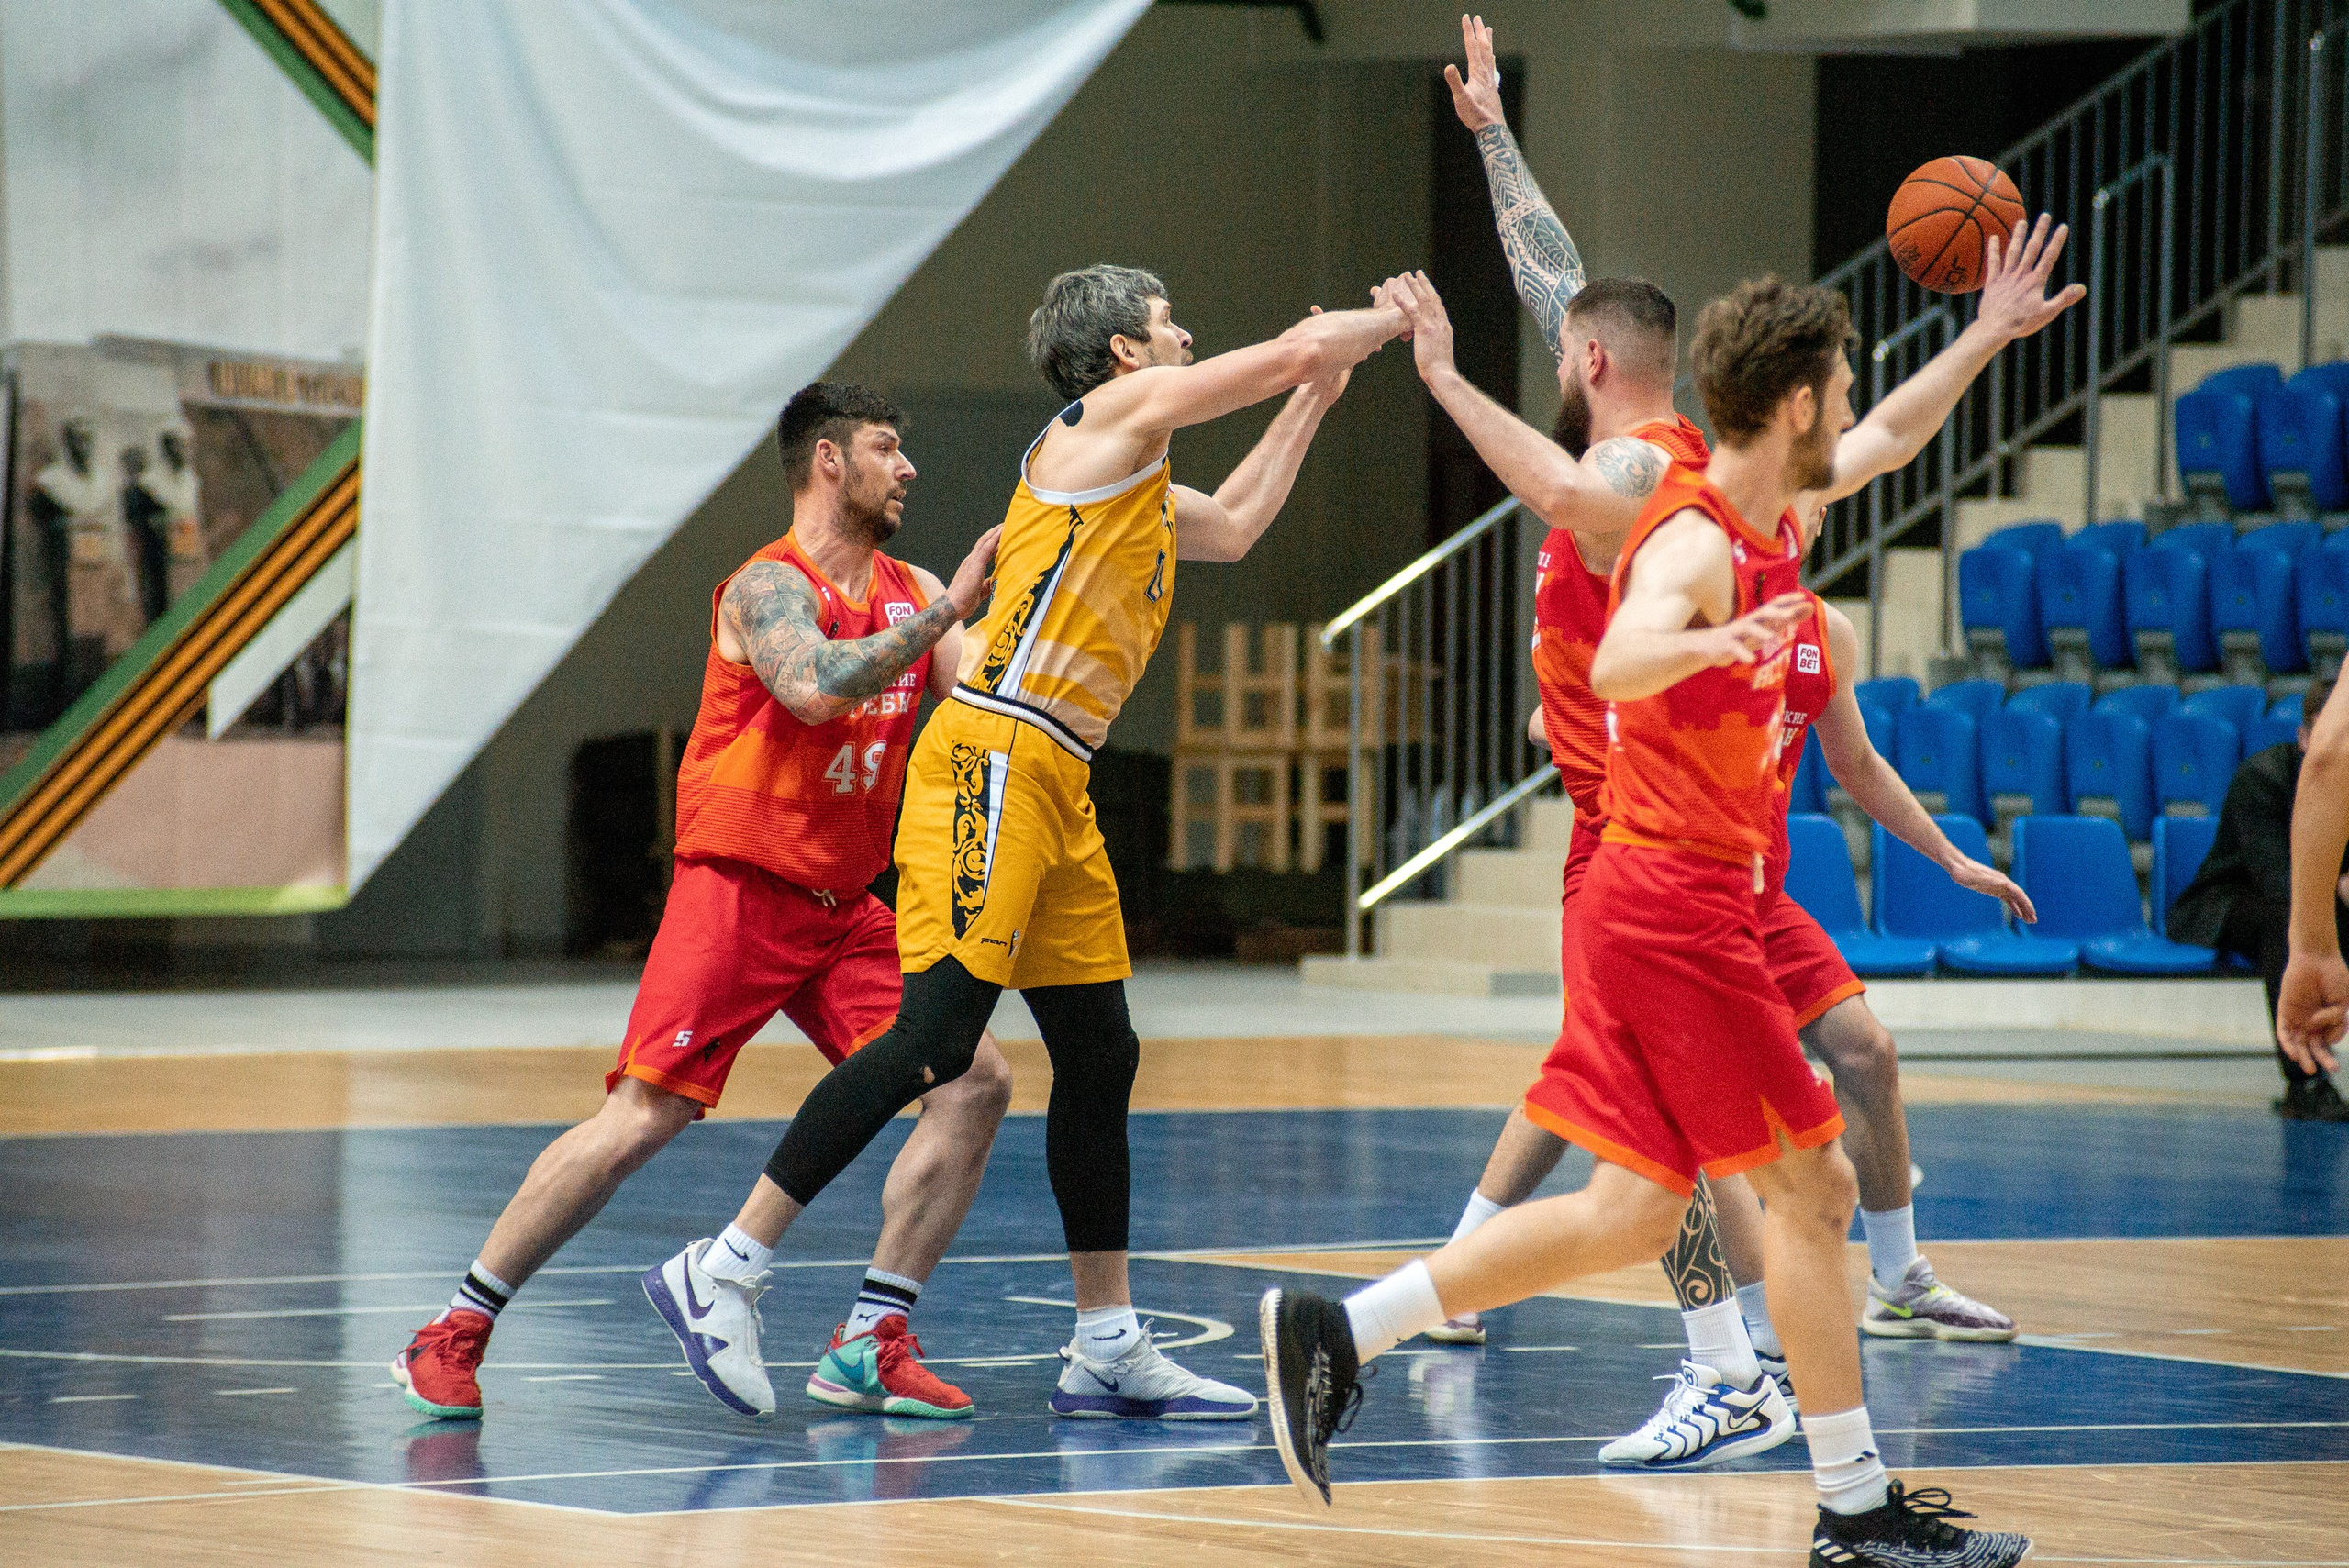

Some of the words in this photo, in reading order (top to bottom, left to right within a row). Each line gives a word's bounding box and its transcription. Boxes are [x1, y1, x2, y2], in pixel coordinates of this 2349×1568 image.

[889, 606, 911, 616] FON
[893, 616, 911, 625] BE
[1799, 648, 1818, 659] FON
[1799, 658, 1818, 670] BET
